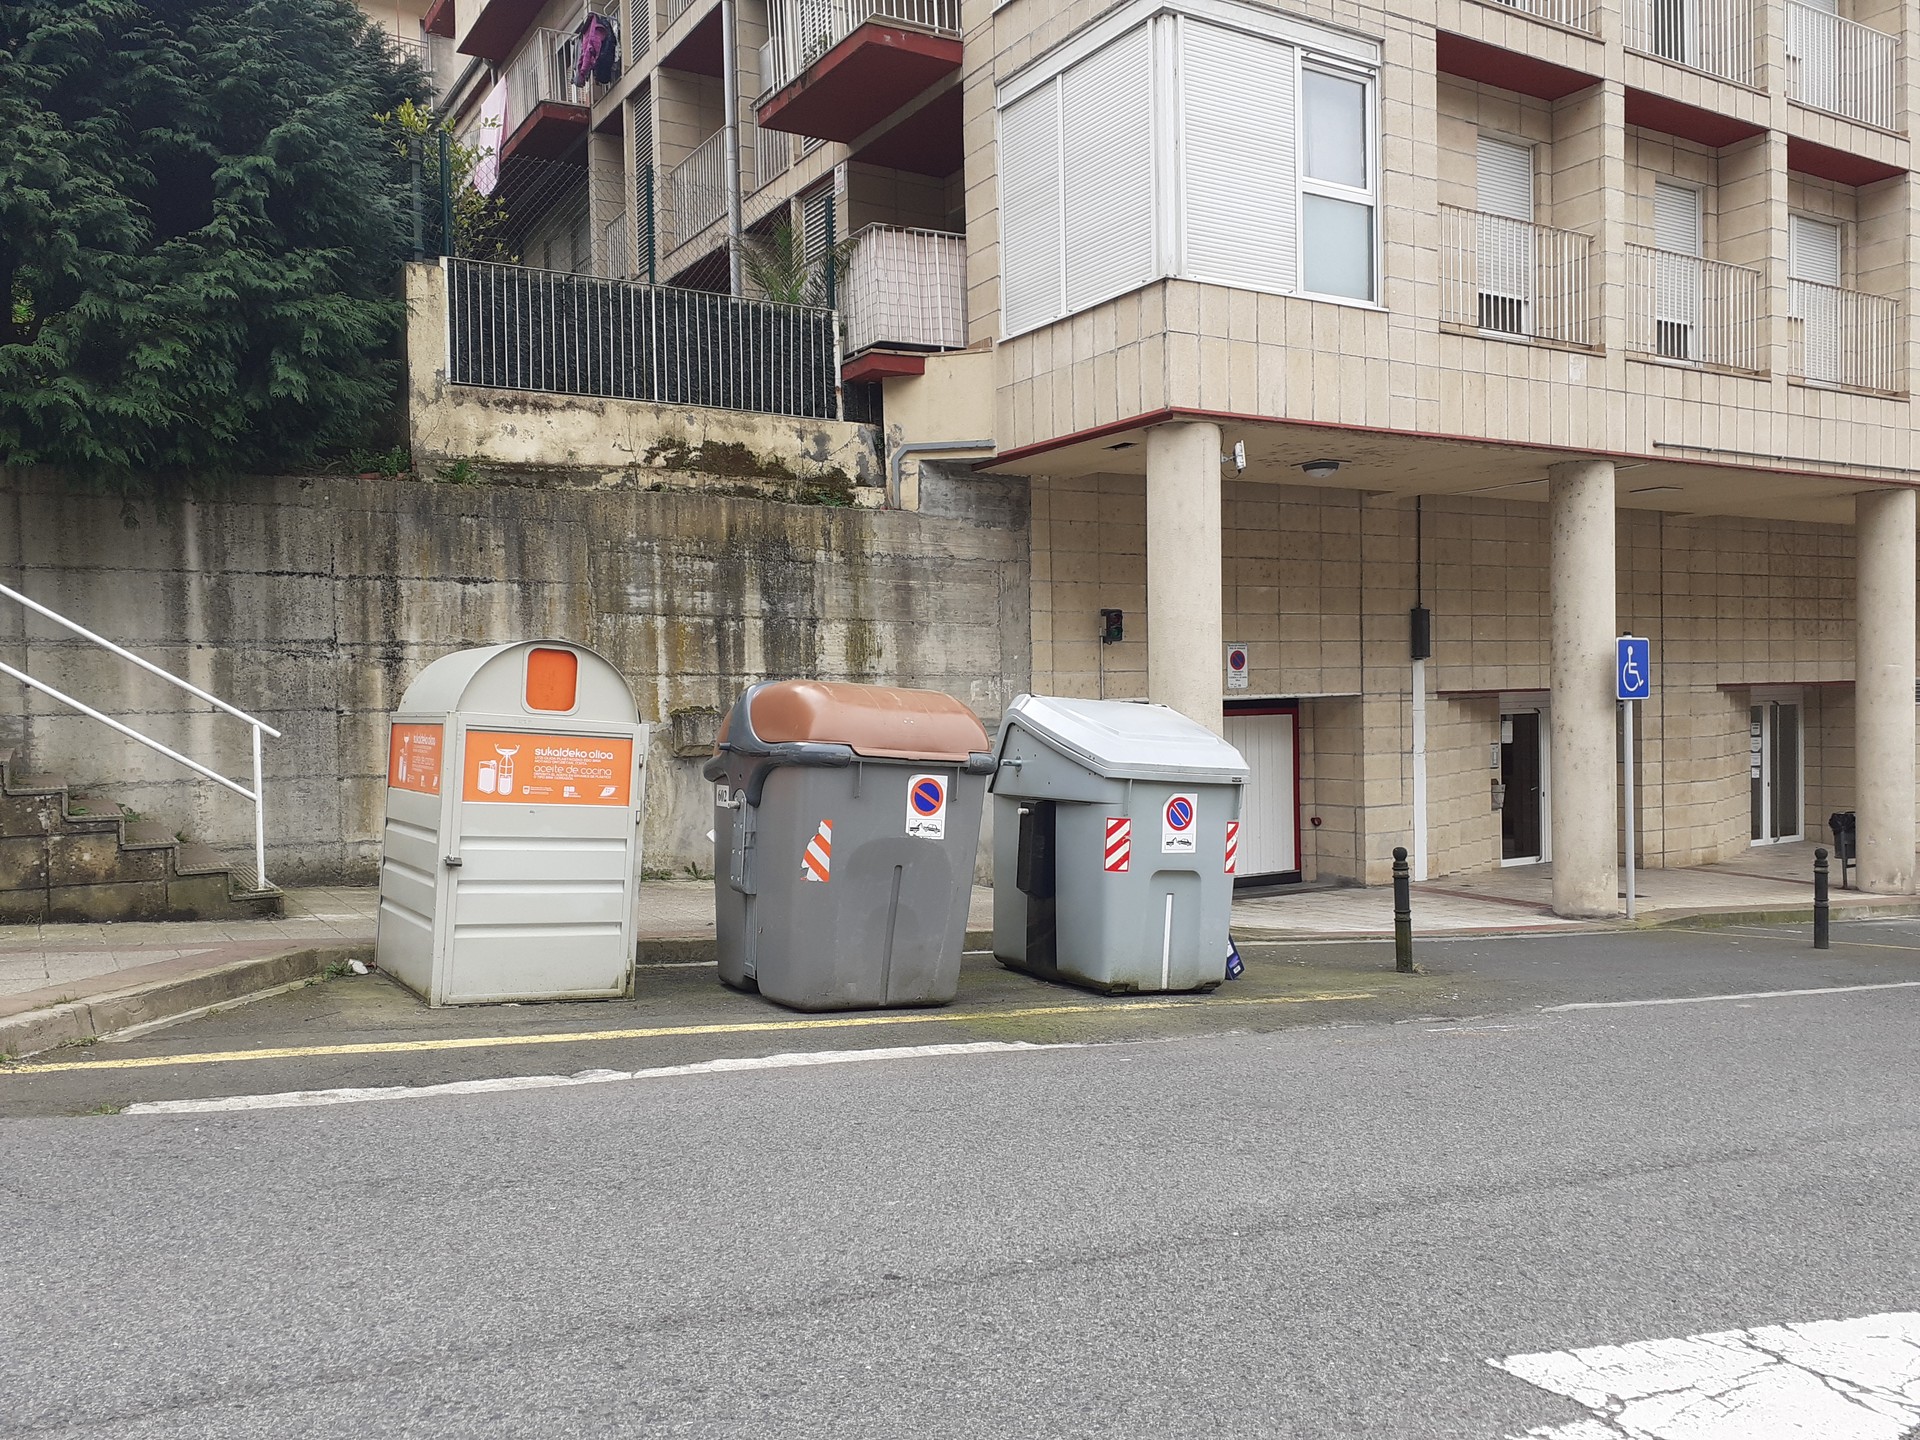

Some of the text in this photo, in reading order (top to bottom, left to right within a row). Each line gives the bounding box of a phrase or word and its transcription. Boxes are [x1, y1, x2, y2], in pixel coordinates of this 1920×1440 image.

[535, 747, 613, 760] sukaldeko olioa
[534, 764, 564, 774] aceite
[565, 765, 578, 774] de
[580, 767, 612, 776] cocina
